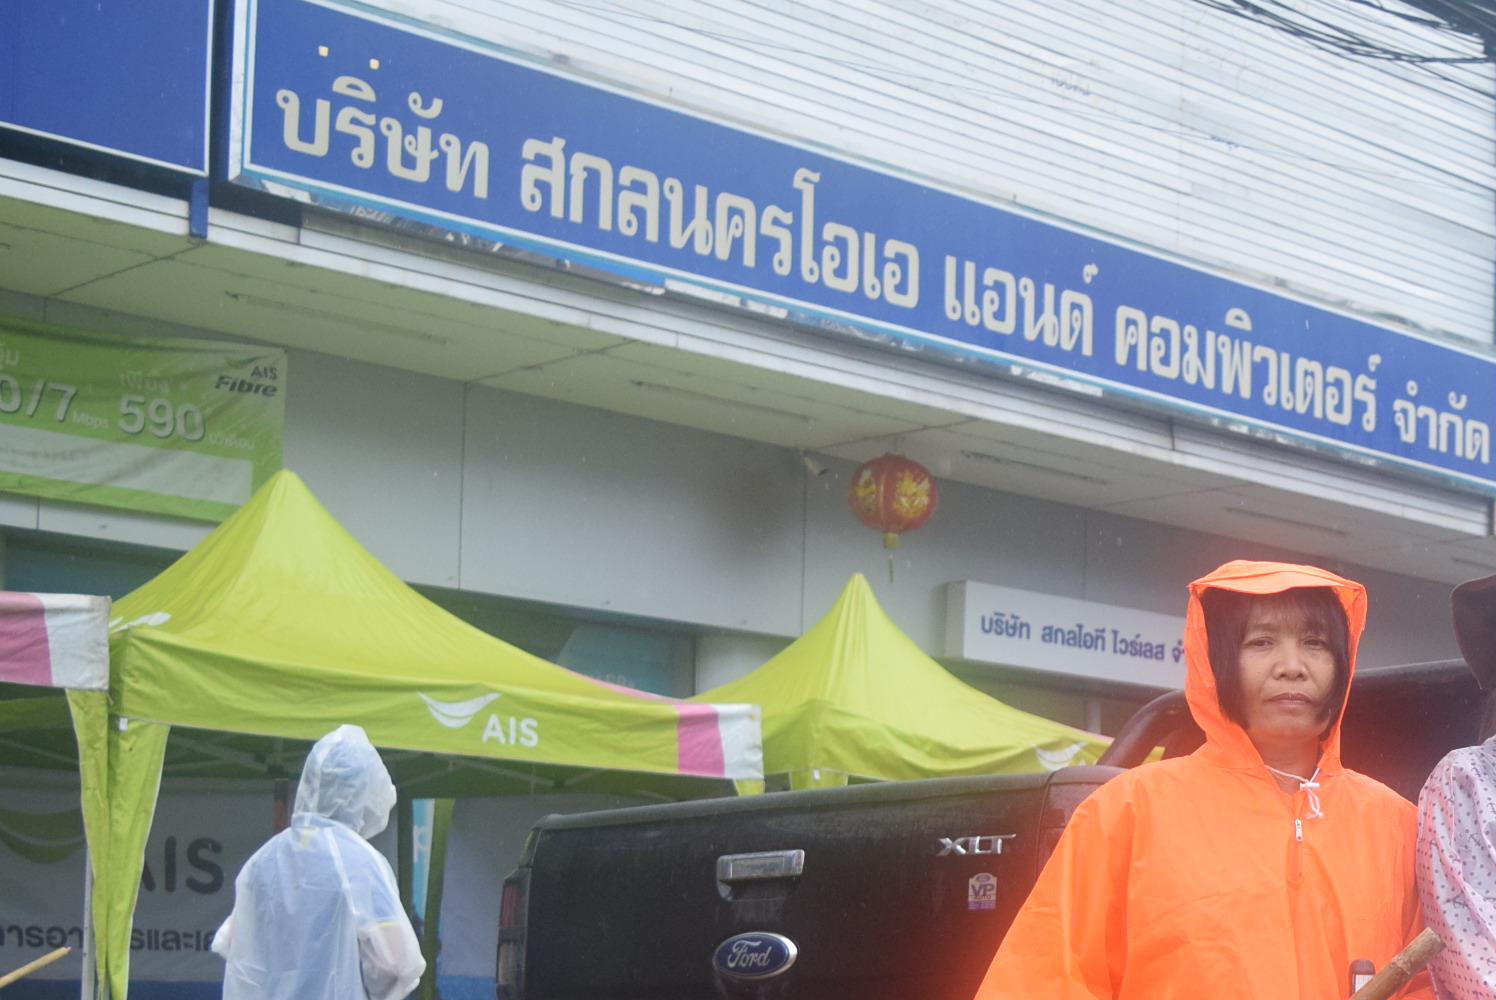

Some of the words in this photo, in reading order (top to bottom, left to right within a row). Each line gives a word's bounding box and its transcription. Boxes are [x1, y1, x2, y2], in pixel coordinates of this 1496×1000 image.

[275, 74, 490, 199] บริษัท
[520, 136, 920, 309] สกลนครโอเอ
[943, 254, 1099, 357] แอนด์
[1114, 305, 1382, 432] คอมพิวเตอร์
[1393, 380, 1491, 464] จำกัด
[215, 375, 278, 397] Fibre
[250, 366, 278, 381] AIS
[118, 393, 206, 442] 590
[980, 612, 1032, 640] บริษัท
[1111, 629, 1166, 661] ไวร์เลส
[482, 714, 539, 747] AIS
[936, 833, 1017, 857] XLT
[726, 939, 771, 969] Ford
